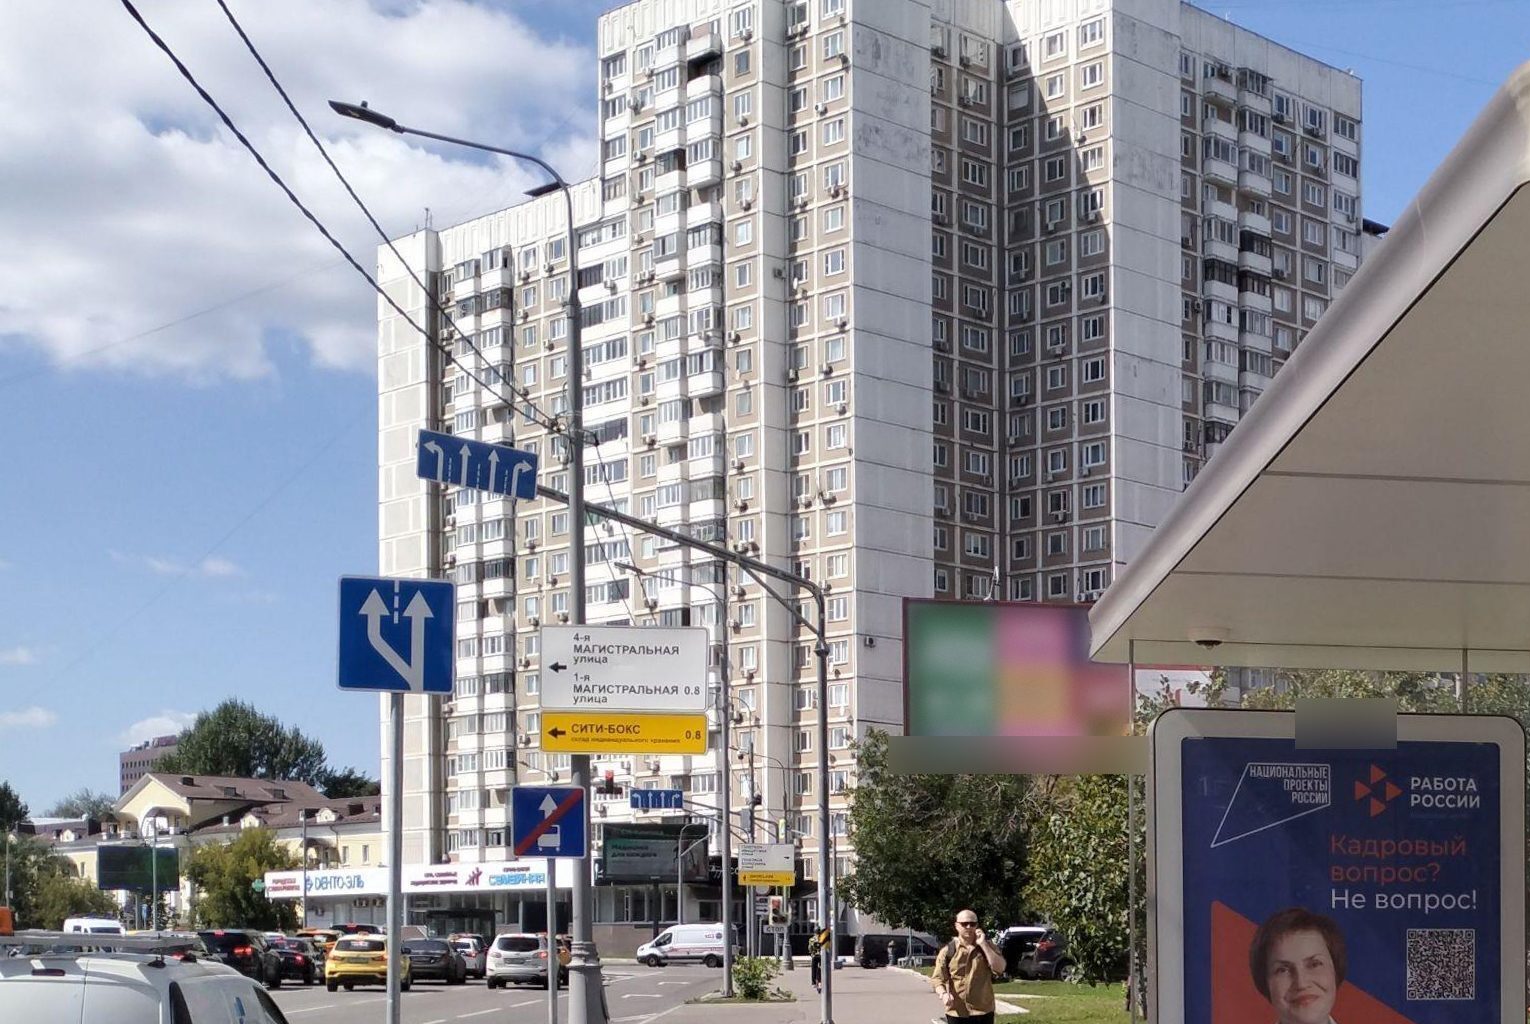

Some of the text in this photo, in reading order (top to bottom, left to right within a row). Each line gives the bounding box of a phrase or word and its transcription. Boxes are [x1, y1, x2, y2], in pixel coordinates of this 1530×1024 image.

[573, 632, 590, 642] 4-я
[573, 644, 680, 656] МАГИСТРАЛЬНАЯ
[573, 655, 608, 664] улица
[574, 673, 590, 682] 1-я
[573, 684, 700, 696] МАГИСТРАЛЬНАЯ 0.8
[573, 694, 608, 704] улица
[571, 723, 701, 740] СИТИ-БОКС 0.8
[1249, 765, 1328, 779] НАЦИОНАЛЬНЫЕ
[1283, 779, 1328, 791] ПРОЕКТЫ
[1410, 776, 1477, 792] РАБОТА
[1291, 791, 1328, 804] РОССИИ
[1410, 794, 1480, 809] РОССИИ
[1331, 834, 1467, 859] Кадровый
[1331, 861, 1441, 886] вопрос?
[1331, 888, 1477, 914] Не вопрос!
